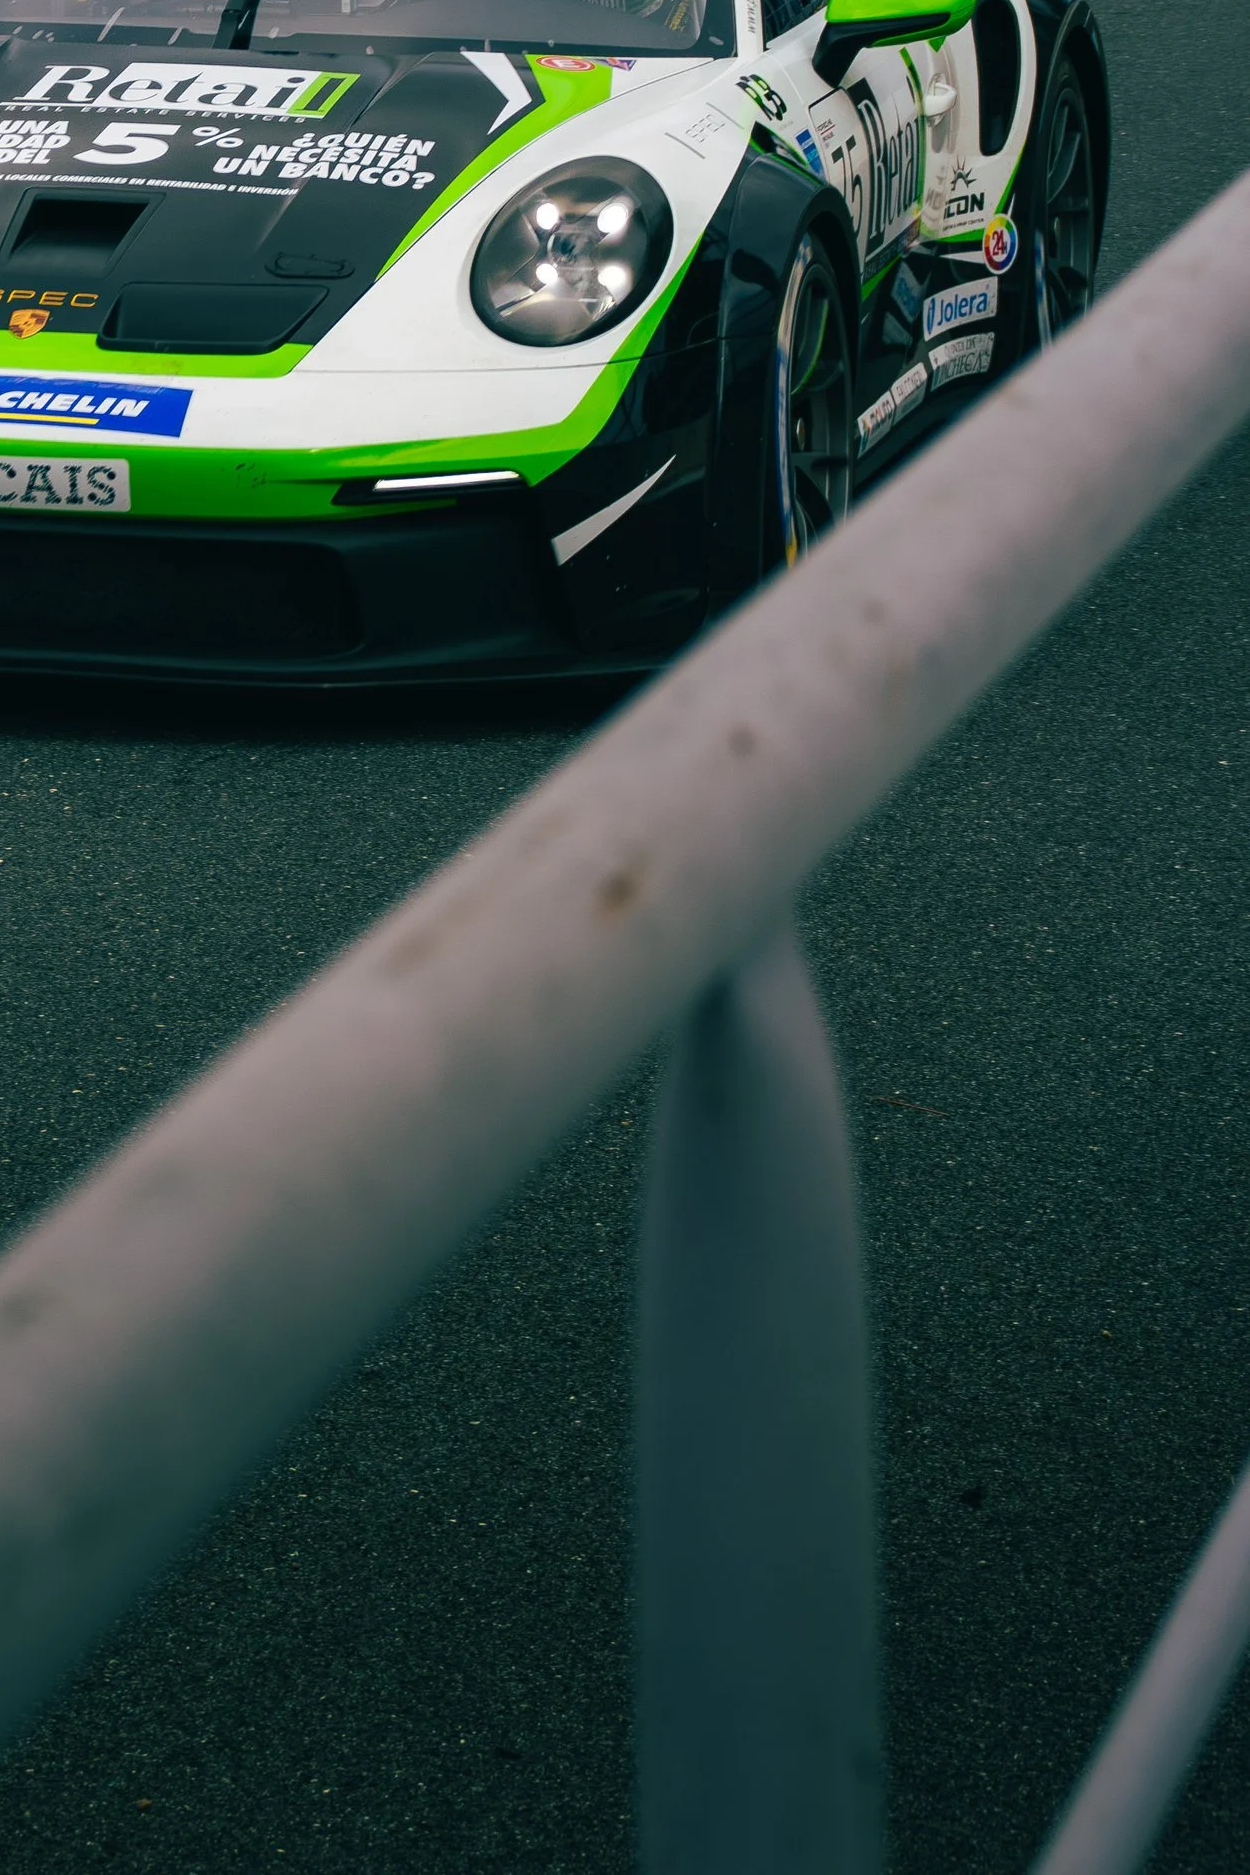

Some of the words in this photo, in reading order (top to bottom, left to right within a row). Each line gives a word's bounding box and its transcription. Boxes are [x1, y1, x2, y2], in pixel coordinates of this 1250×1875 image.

[11, 63, 348, 113] Retail
[4, 105, 64, 113] REAL
[81, 106, 169, 116] ESTATE
[184, 110, 308, 124] SERVICES
[73, 122, 182, 165] 5
[191, 126, 245, 149] %
[247, 144, 418, 172] NECESITA
[291, 131, 436, 157] ¿QUIÉN
[857, 76, 920, 239] Retai
[4, 174, 51, 182] LOCALES
[51, 175, 129, 185] COMERCIALES
[128, 177, 145, 185] EN
[146, 178, 228, 191] RENTABILIDAD
[237, 185, 300, 196] INVERSIÓN
[212, 157, 272, 176] UN
[277, 162, 436, 190] BANCO?
[937, 292, 989, 326] Jolera
